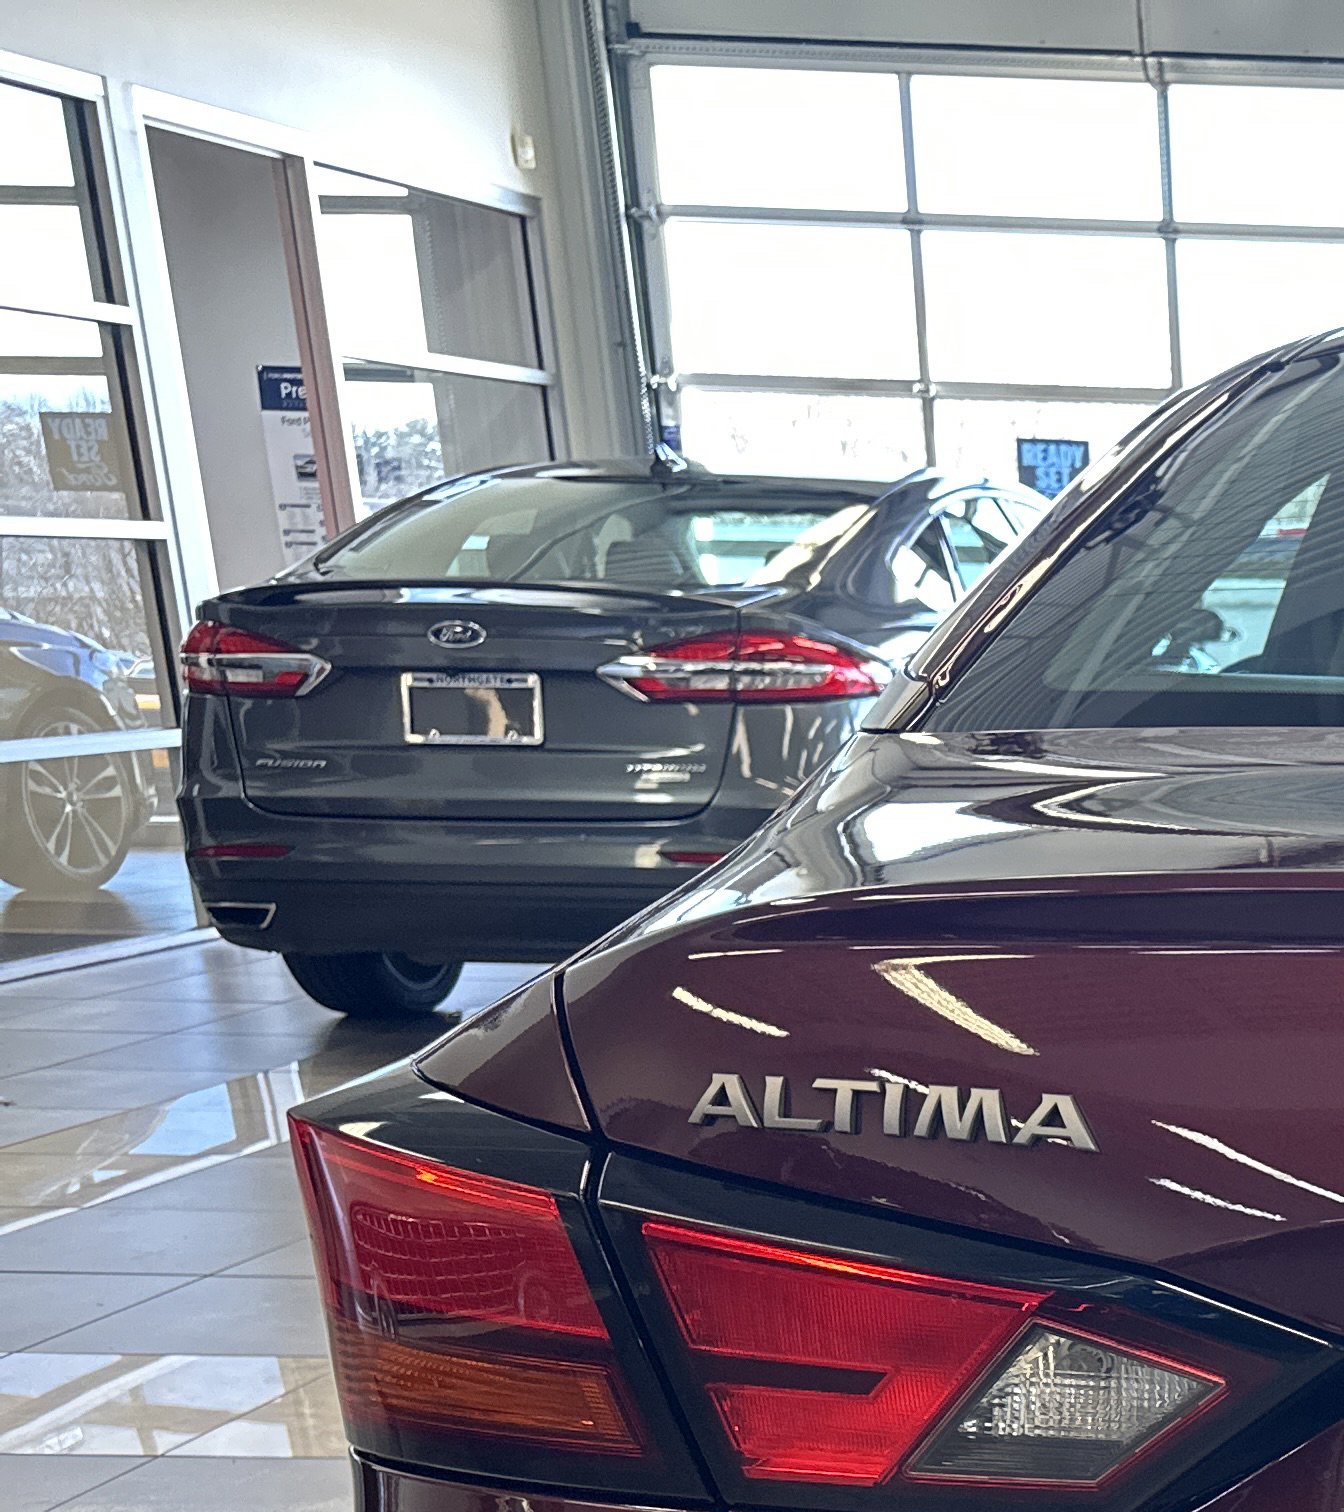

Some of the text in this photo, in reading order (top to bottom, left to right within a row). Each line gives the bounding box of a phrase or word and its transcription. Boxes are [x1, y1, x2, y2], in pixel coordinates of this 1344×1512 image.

[1021, 442, 1085, 468] READY
[1034, 465, 1071, 488] SET
[255, 758, 328, 769] FUSION
[687, 1072, 1101, 1153] ALTIMA
